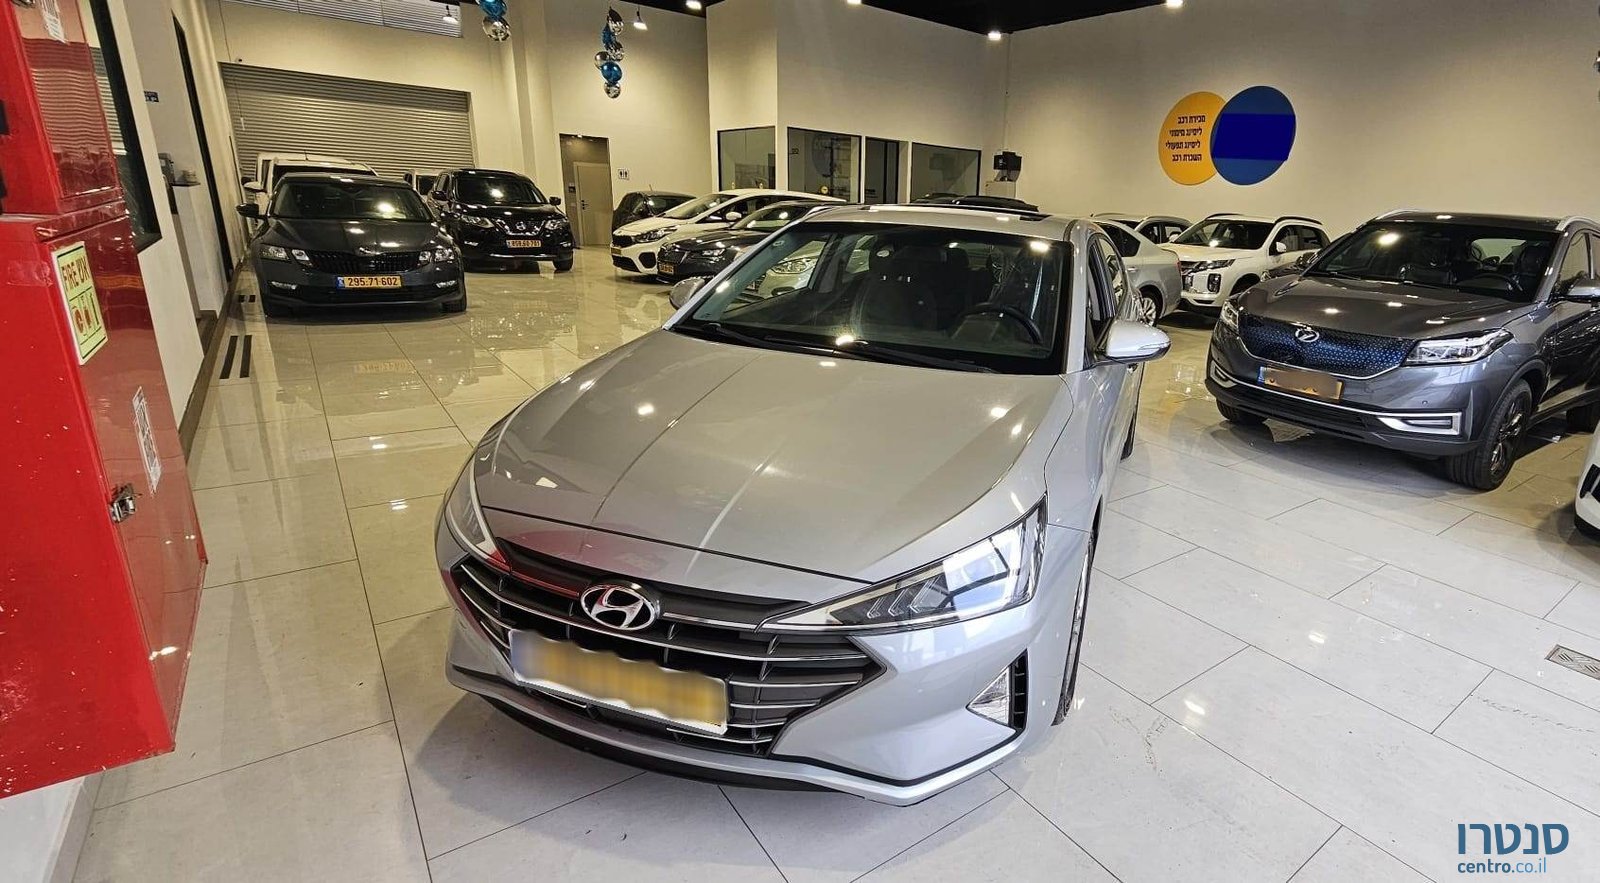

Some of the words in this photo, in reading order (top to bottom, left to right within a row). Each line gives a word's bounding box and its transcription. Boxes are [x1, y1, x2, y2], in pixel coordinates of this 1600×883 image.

[1177, 116, 1188, 124] רכב
[1189, 115, 1205, 123] מכירת
[1186, 126, 1202, 136] ליסינג
[1184, 139, 1200, 148] ליסינג
[1172, 154, 1182, 162] רכב
[1183, 153, 1202, 162] השכרת
[61, 261, 79, 292] FIRE
